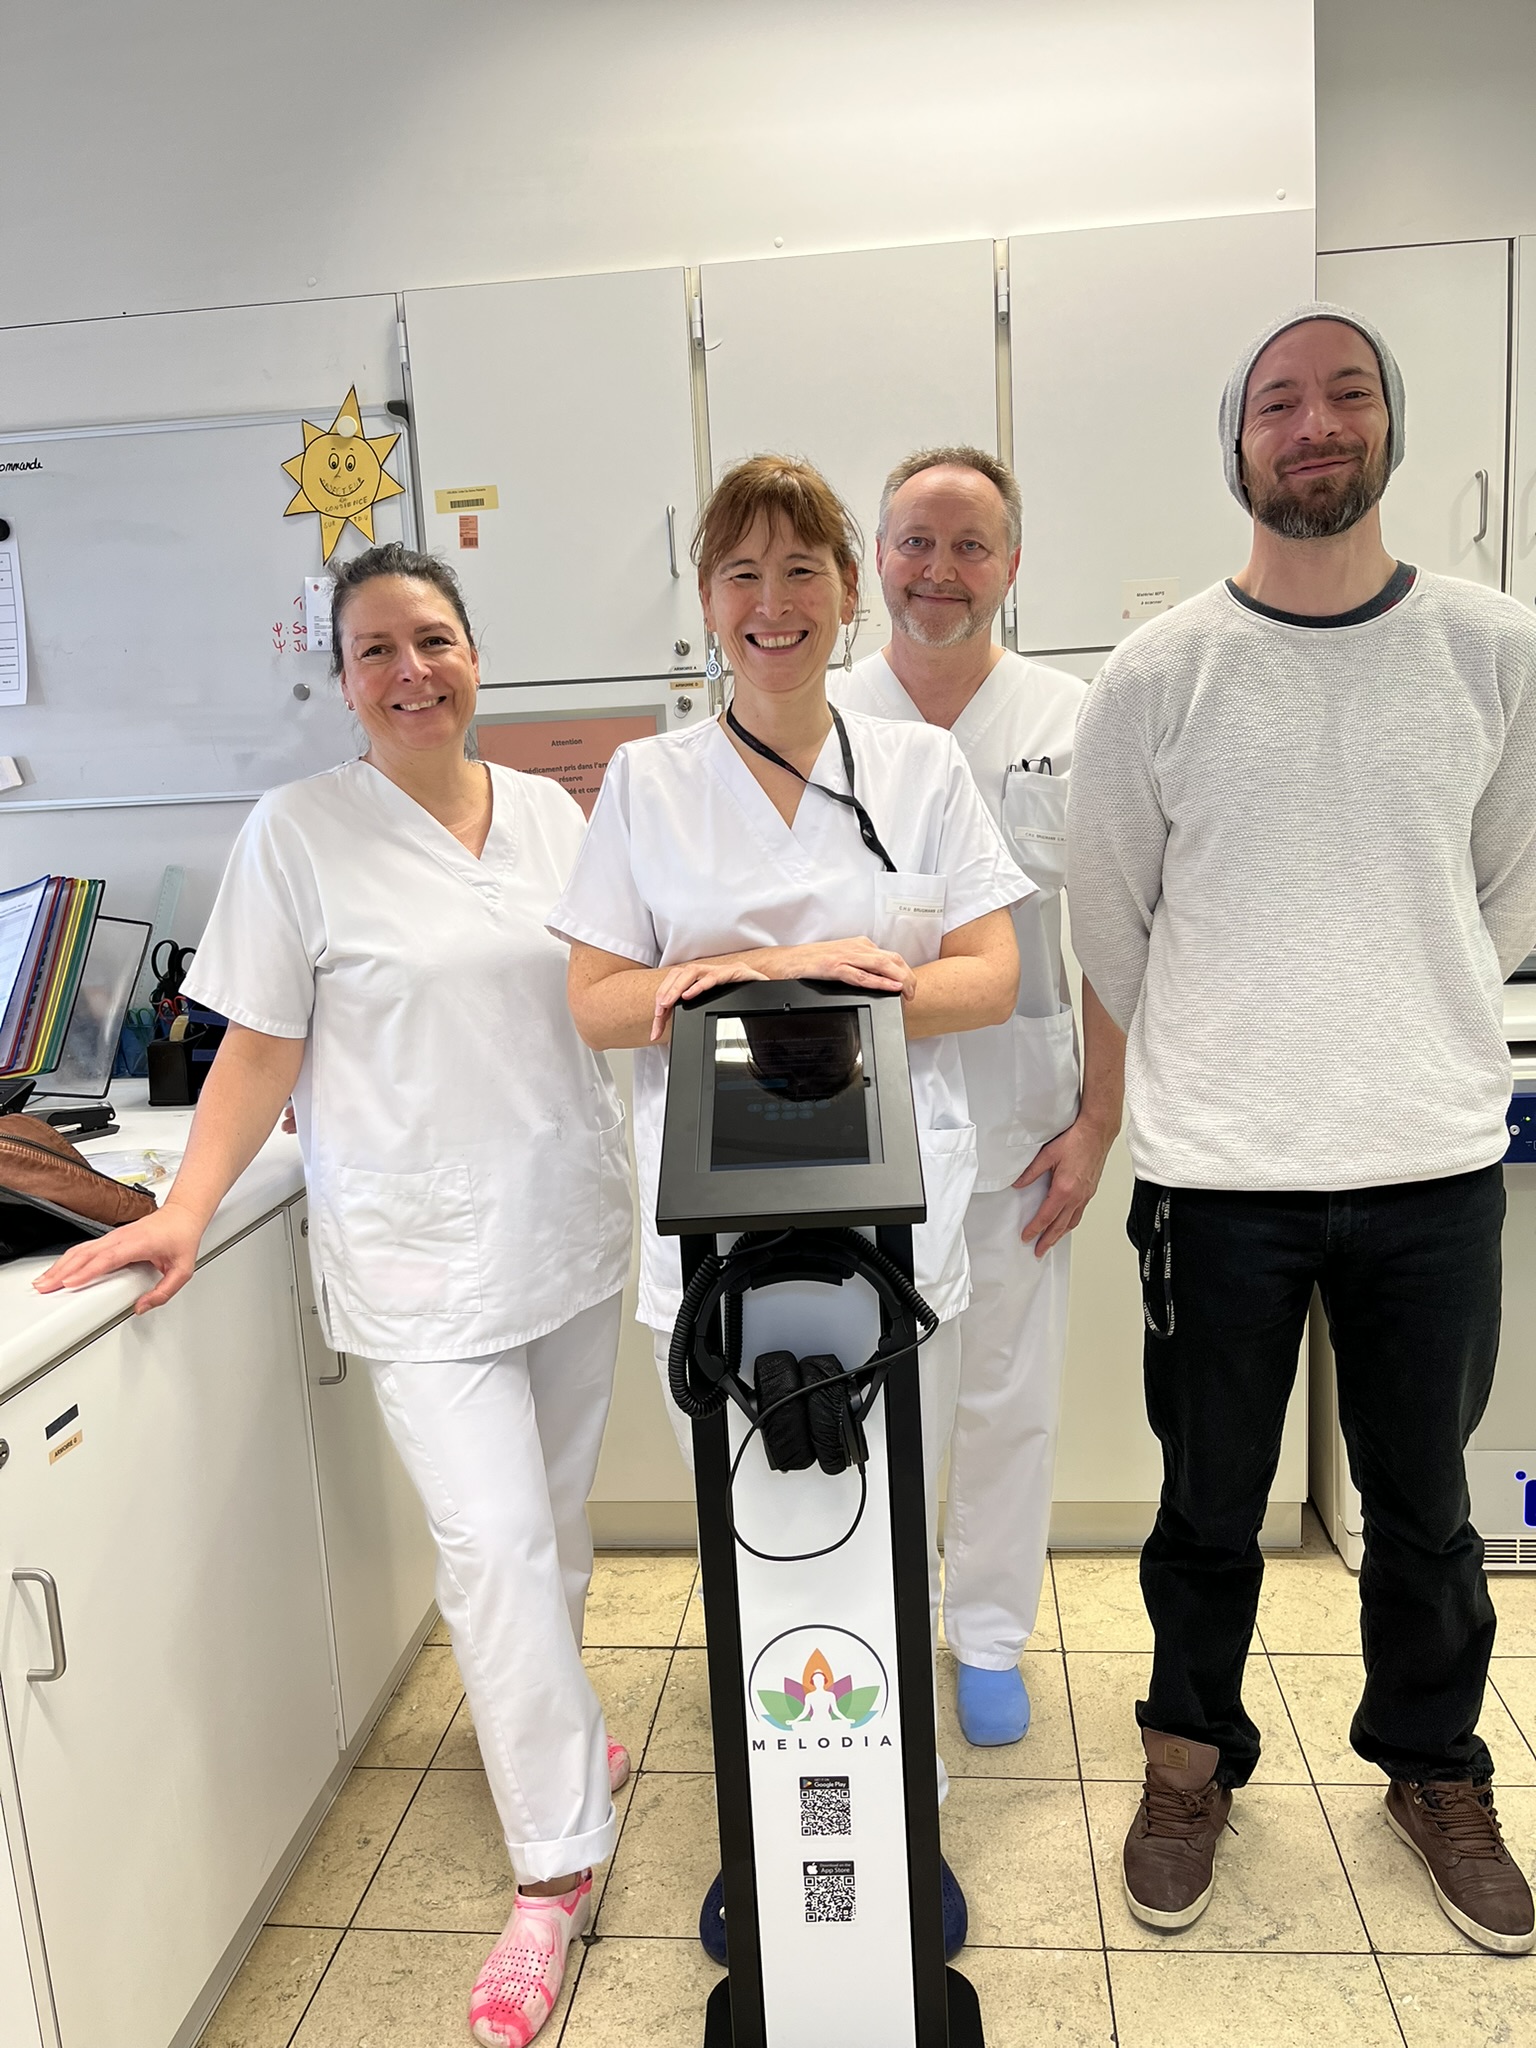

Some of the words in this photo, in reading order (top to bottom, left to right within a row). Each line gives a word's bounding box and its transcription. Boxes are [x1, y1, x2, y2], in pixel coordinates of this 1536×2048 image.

[551, 738, 583, 747] Attention
[564, 764, 576, 772] pris
[577, 761, 593, 770] dans
[558, 775, 583, 783] réserve
[752, 1735, 892, 1751] MELODIA
[834, 1780, 847, 1788] Play
